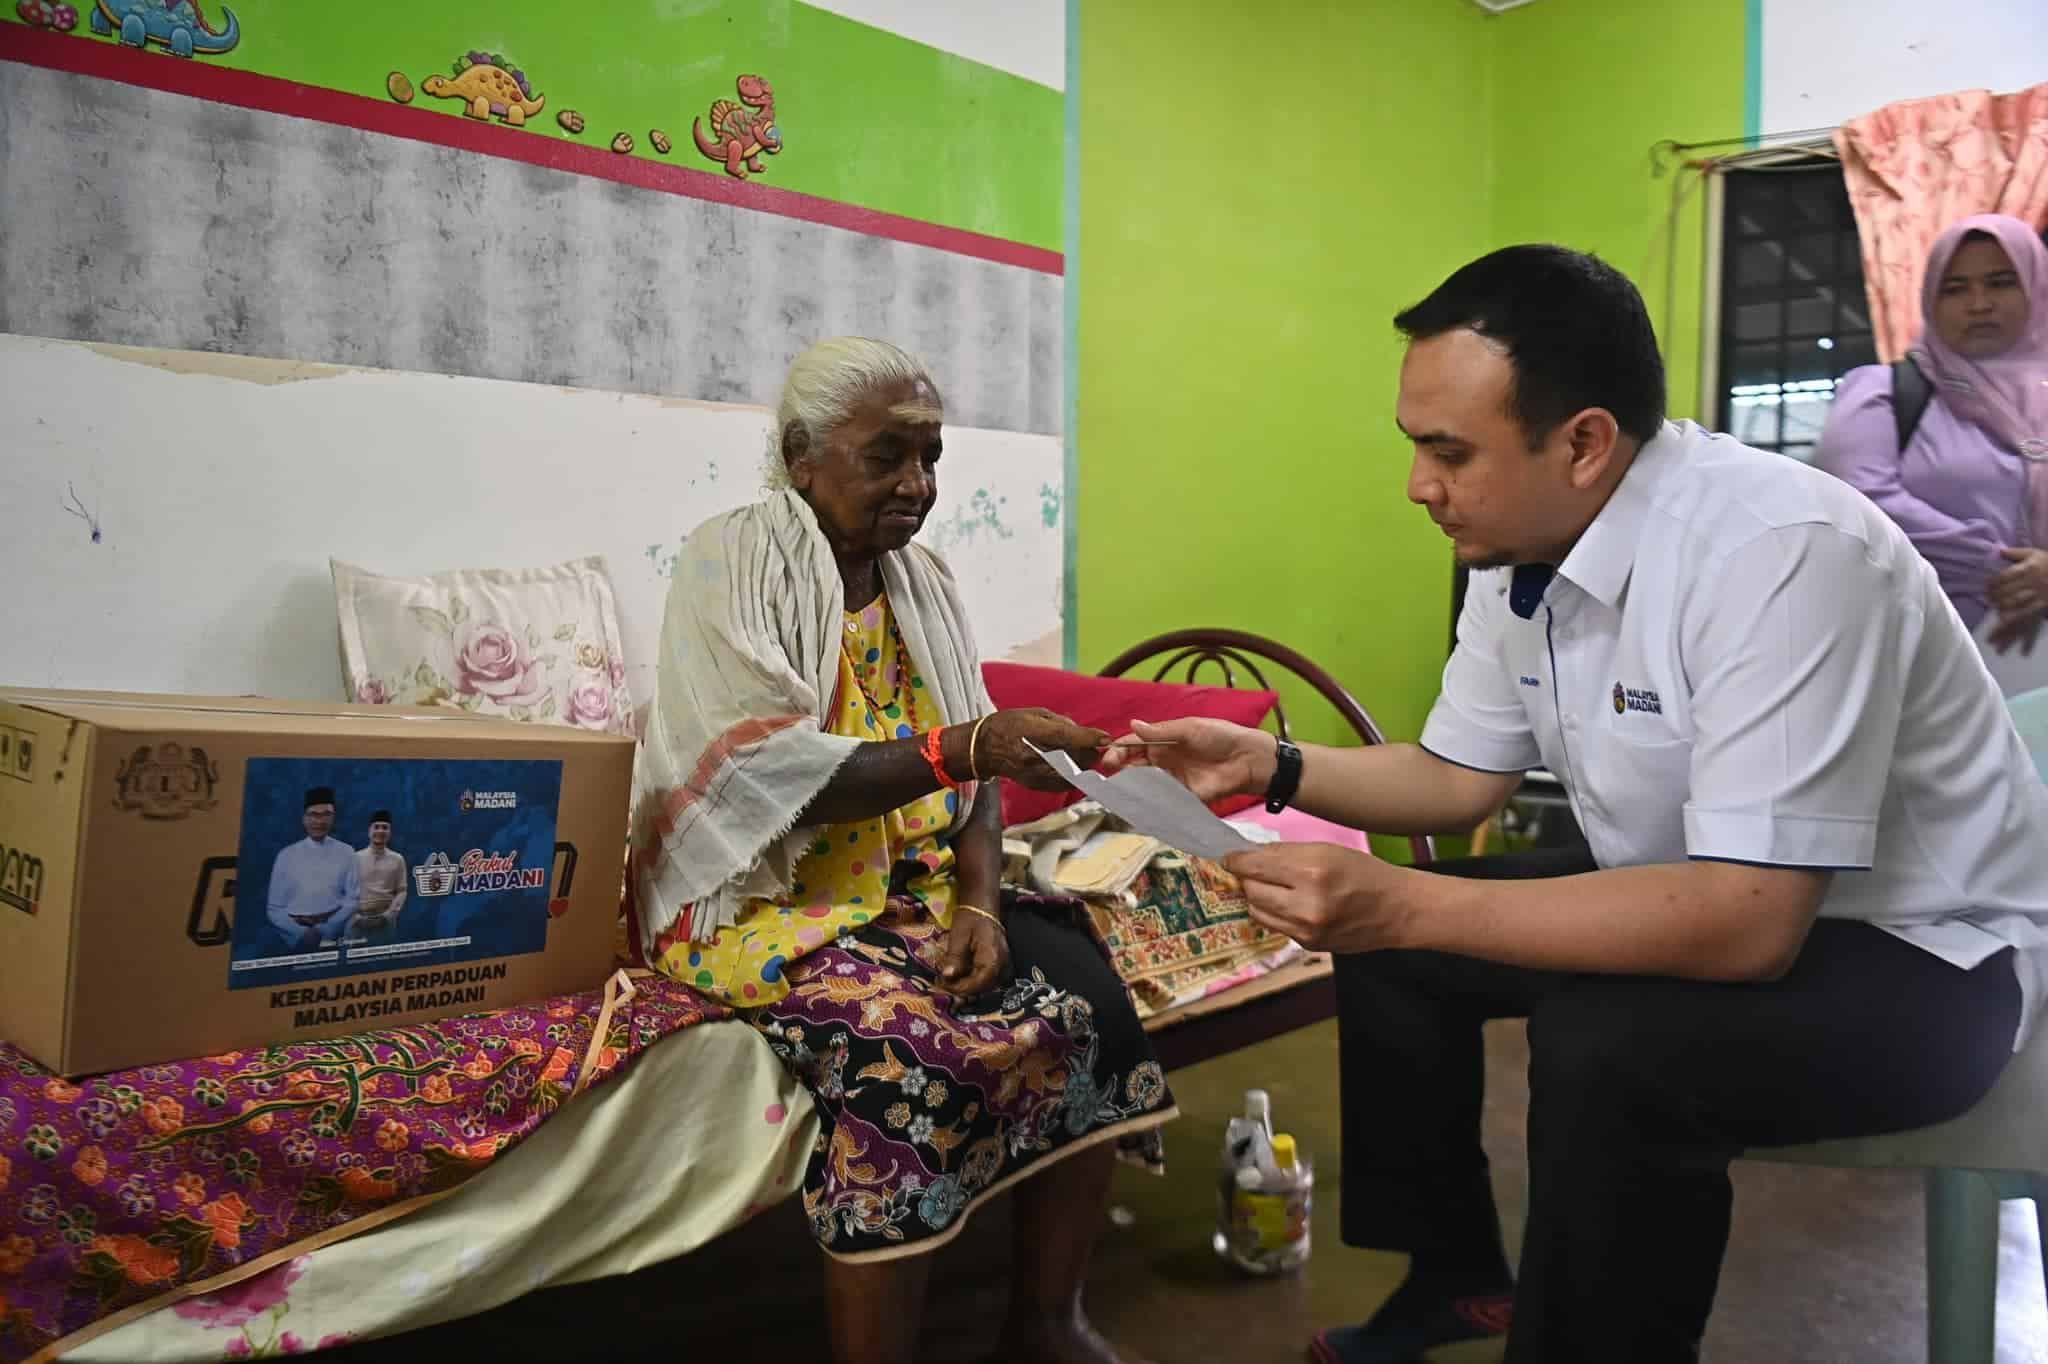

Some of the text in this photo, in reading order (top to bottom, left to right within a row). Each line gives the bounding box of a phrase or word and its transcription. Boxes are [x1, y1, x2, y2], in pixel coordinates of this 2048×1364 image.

[1626, 698, 1662, 715] MADANI
[474, 799, 516, 809] MADANI
[475, 791, 516, 799] MALAYSIA
[0, 842, 43, 908] AH
[460, 848, 518, 876] Bakul
[455, 868, 545, 893] MADANI
[270, 963, 507, 1008] KERAJAAN PERPADUAN
[293, 985, 485, 1028] MALAYSIA MADANI
